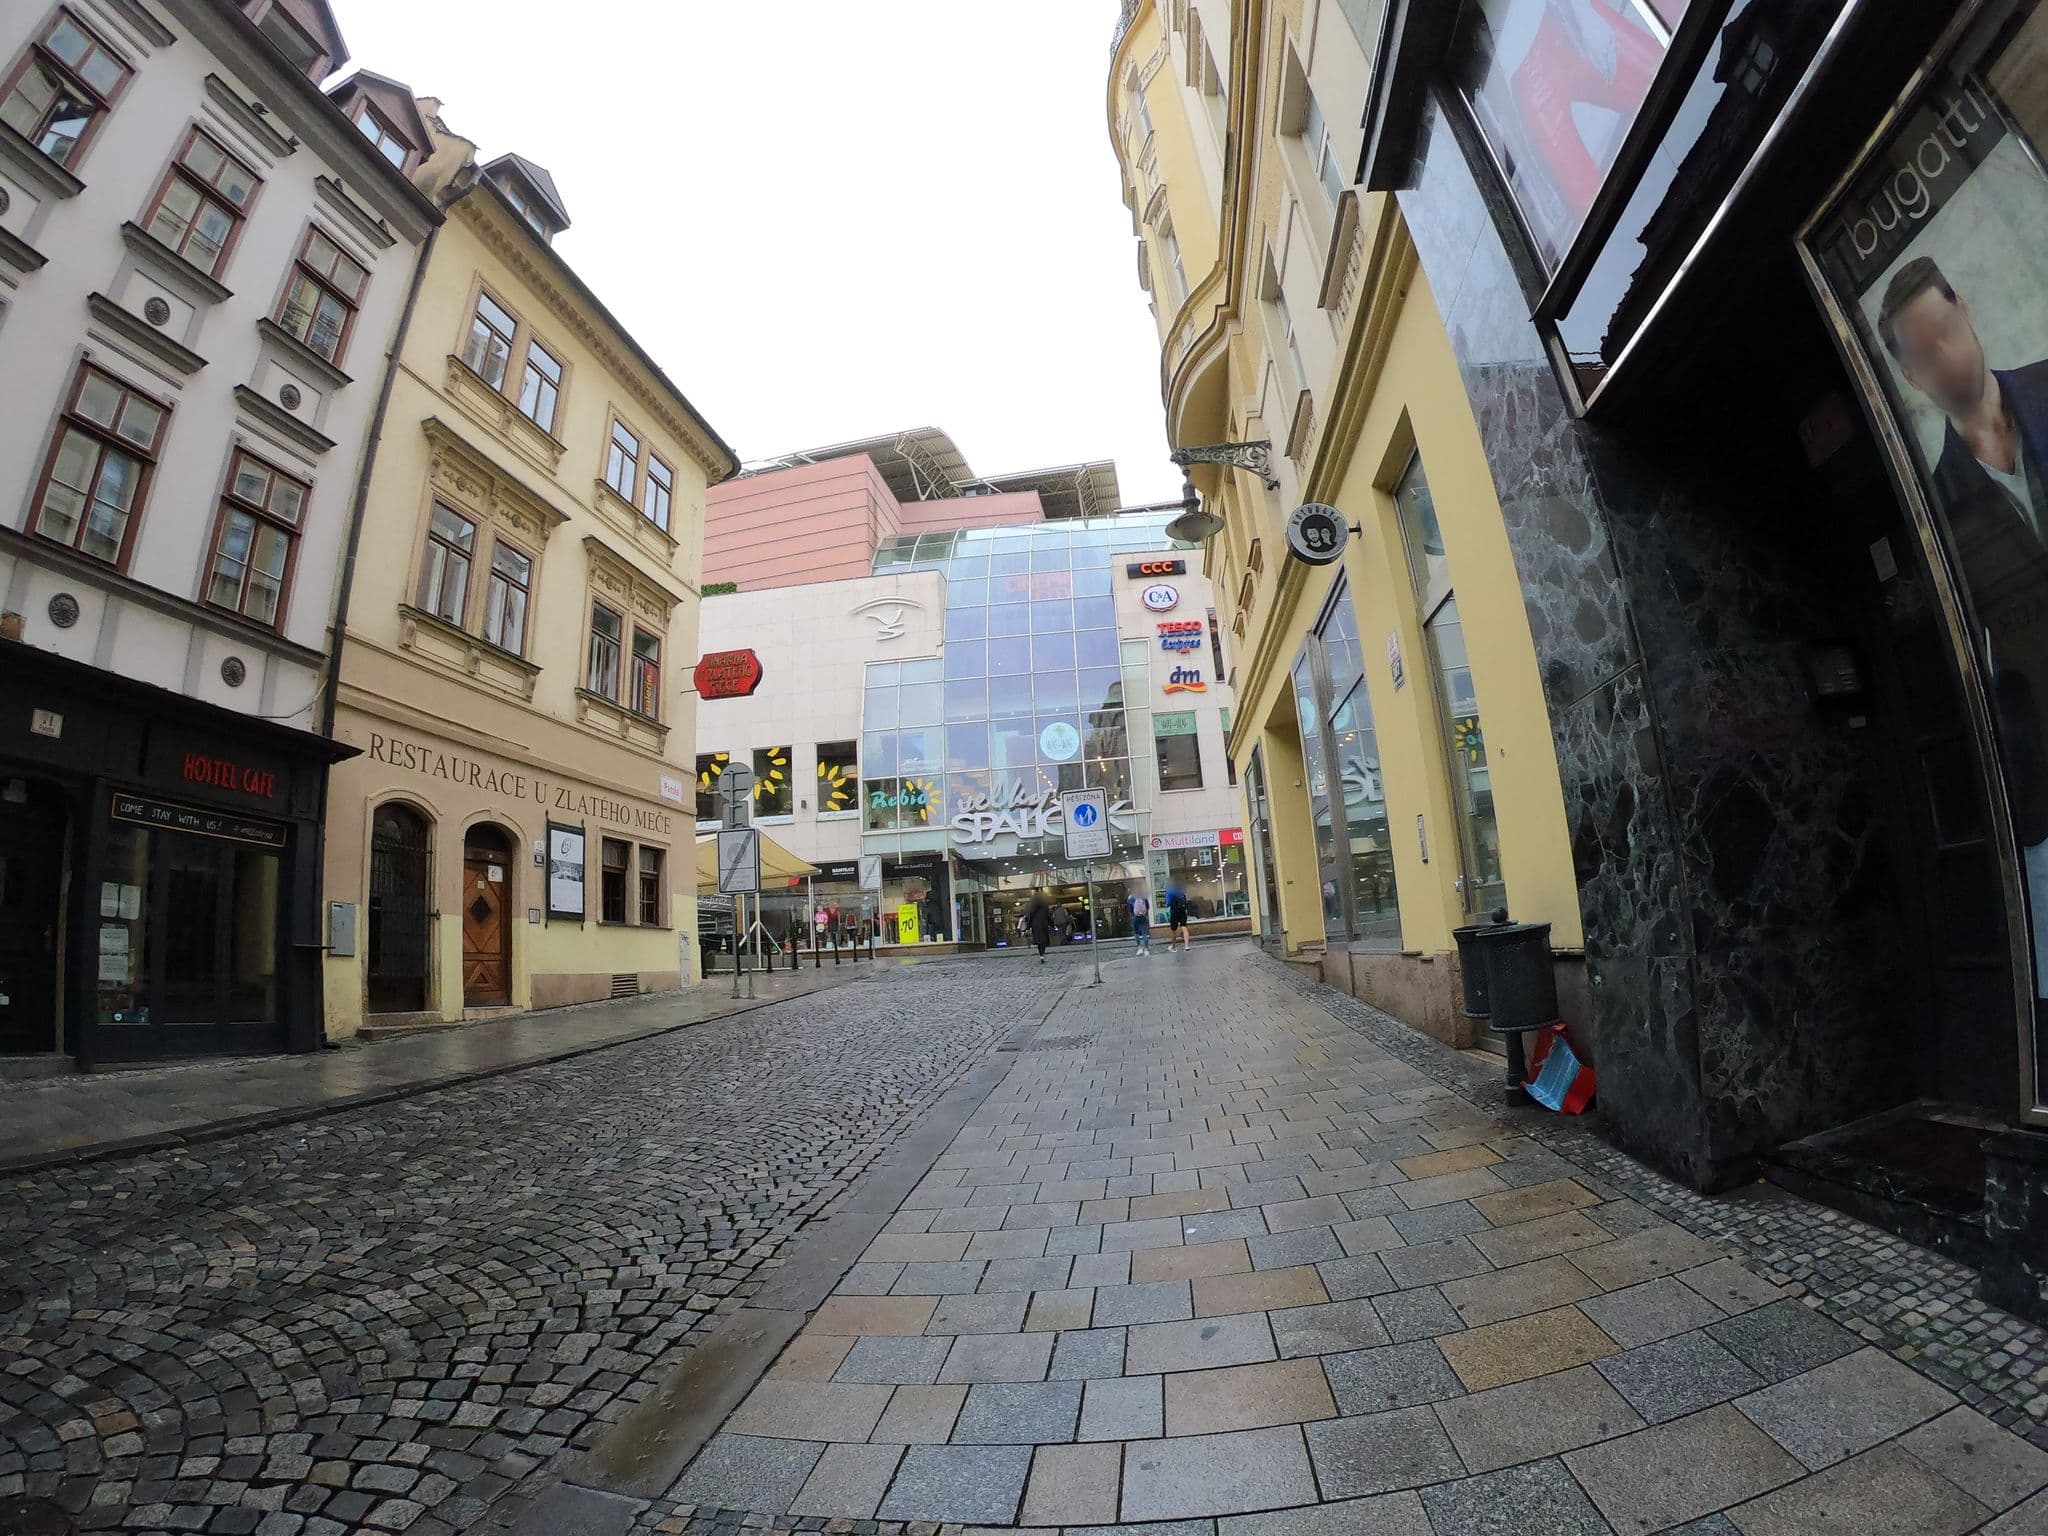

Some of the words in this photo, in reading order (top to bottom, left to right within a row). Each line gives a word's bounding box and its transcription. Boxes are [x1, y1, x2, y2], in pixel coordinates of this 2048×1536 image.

[1841, 88, 1987, 261] bugatti
[1141, 561, 1173, 574] CCC
[1148, 590, 1173, 603] C&A
[1157, 621, 1203, 633] TESCO
[1169, 665, 1200, 684] dm
[368, 732, 527, 799] RESTAURACE
[535, 781, 547, 804] U
[555, 787, 631, 825] ZLATÉHO
[635, 809, 672, 835] MEČE
[871, 788, 928, 809] Rebio
[119, 802, 144, 816] COME
[151, 807, 172, 821] STAY
[178, 810, 200, 828] WITH
[1165, 833, 1215, 848] Multiland
